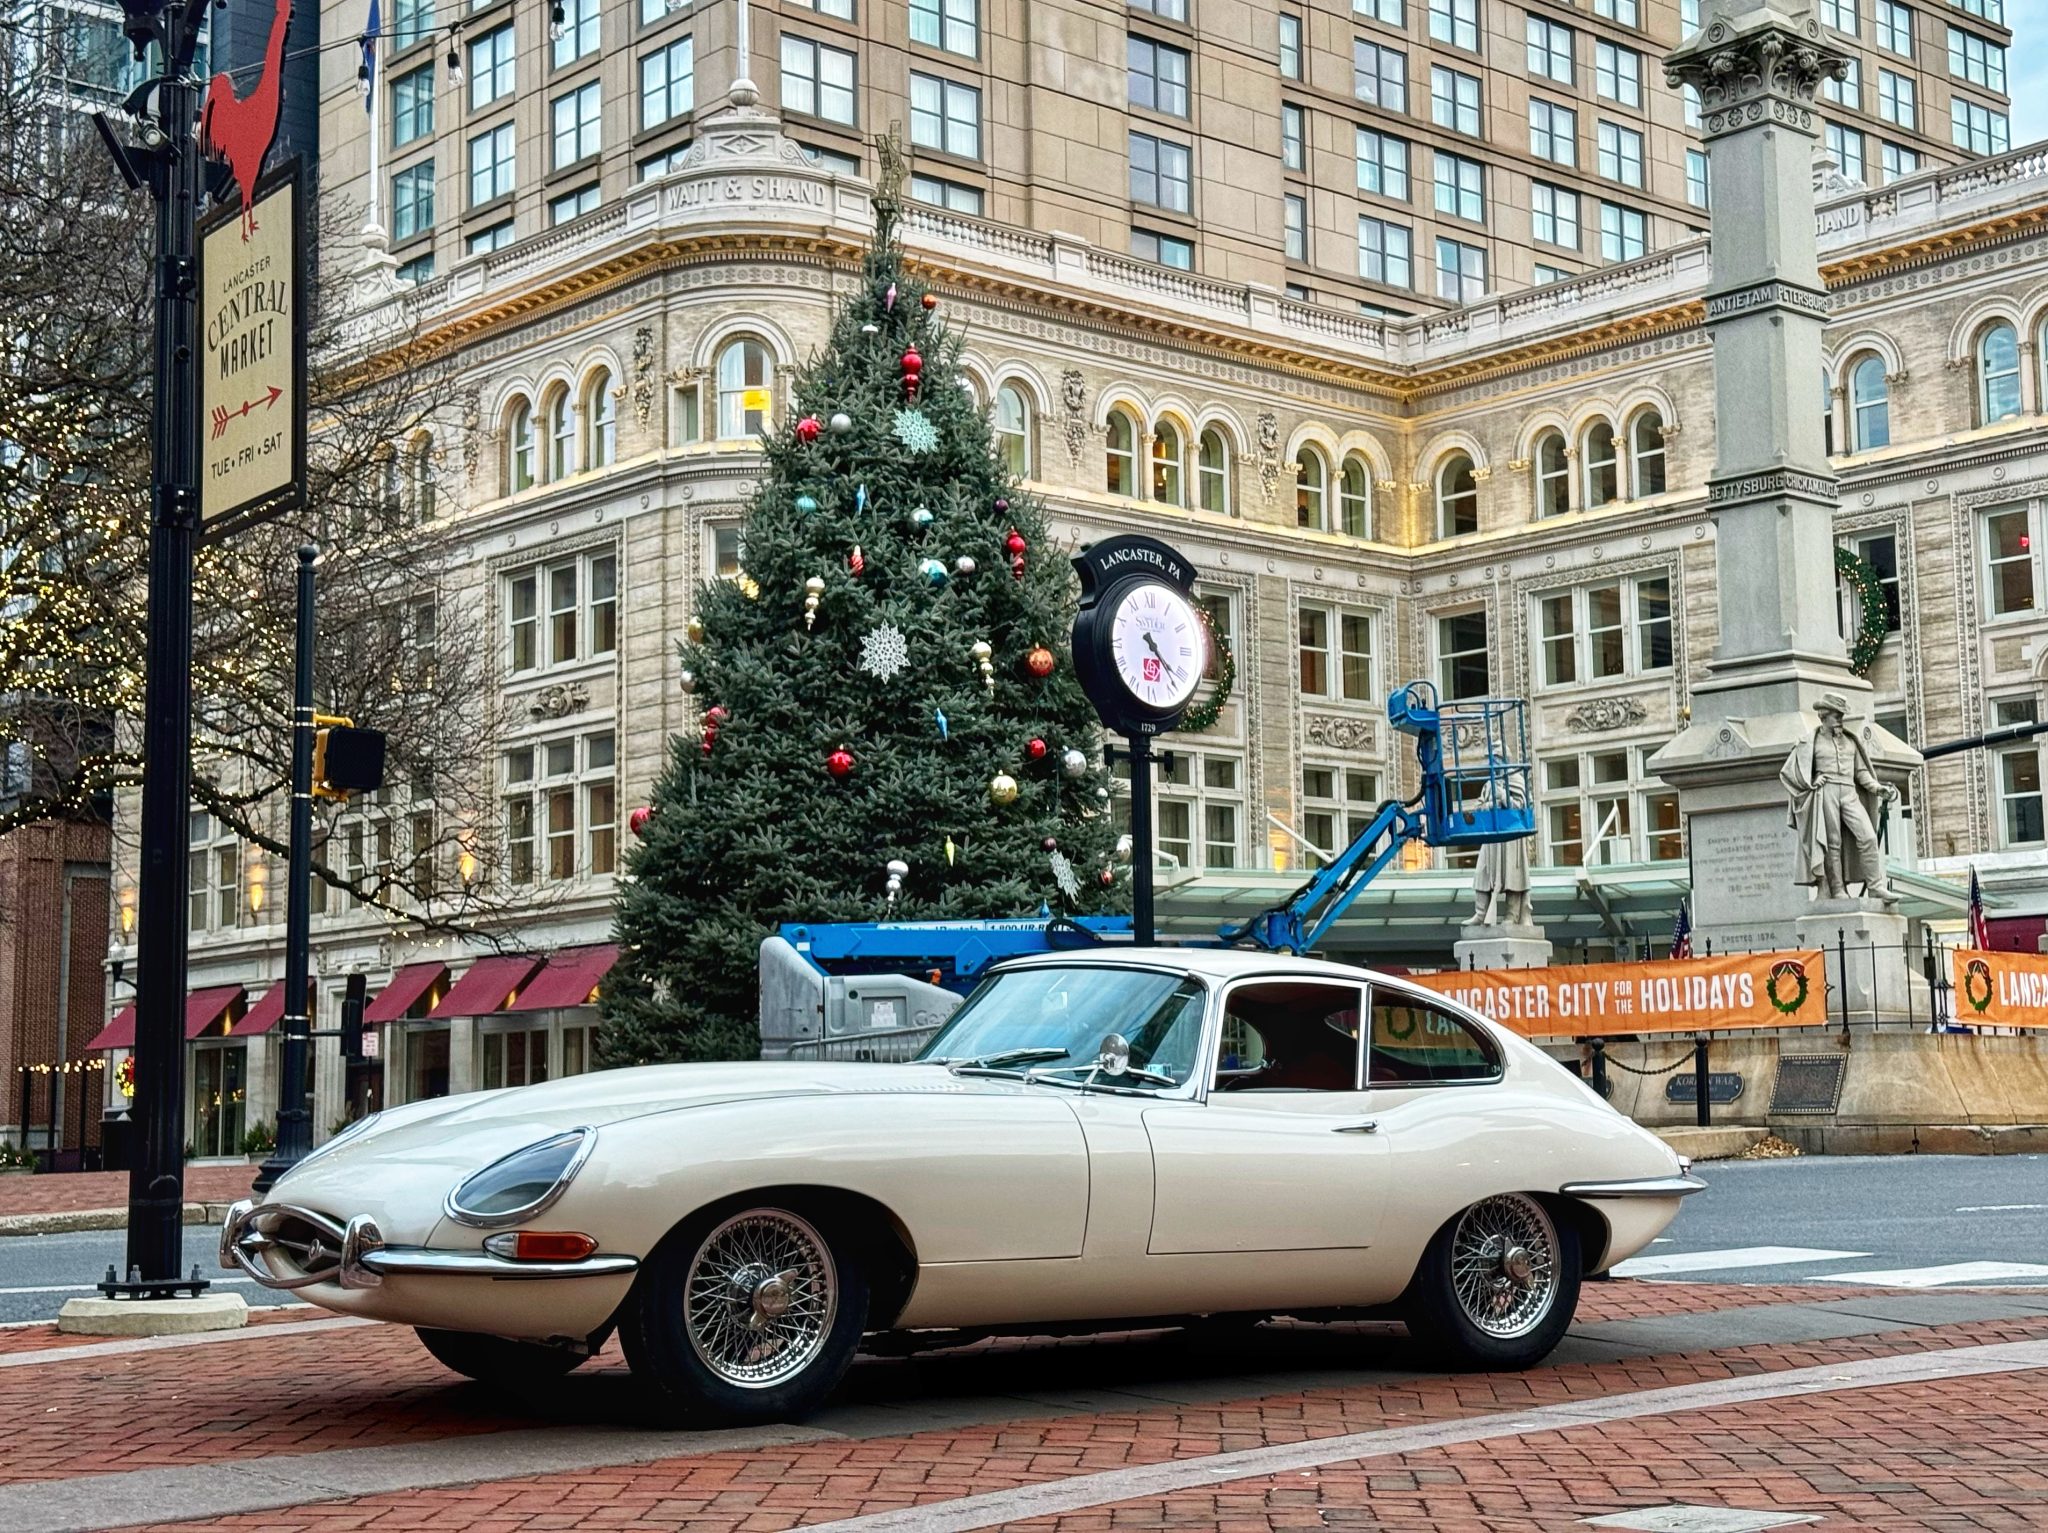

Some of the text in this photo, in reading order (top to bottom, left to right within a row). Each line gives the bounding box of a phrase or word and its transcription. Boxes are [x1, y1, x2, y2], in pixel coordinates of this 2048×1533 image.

[668, 177, 824, 210] WATT & SHAND
[1815, 207, 1860, 237] HAND
[223, 256, 271, 293] LANCASTER
[208, 279, 288, 352] CENTRAL
[1710, 285, 1828, 316] ANTIETAM PETERSBURG
[220, 318, 273, 380] MARKET
[211, 432, 282, 479] TUE FRI SAT
[1709, 474, 1839, 500] GETTYSBURG CHICKAMAUGA
[1100, 548, 1181, 580] LANCASTER, PA
[1141, 722, 1156, 733] 1729
[1558, 981, 1608, 1017] CITY
[1614, 980, 1632, 996] FOR
[1640, 972, 1754, 1013] HOLIDAYS
[1615, 999, 1633, 1014] THE
